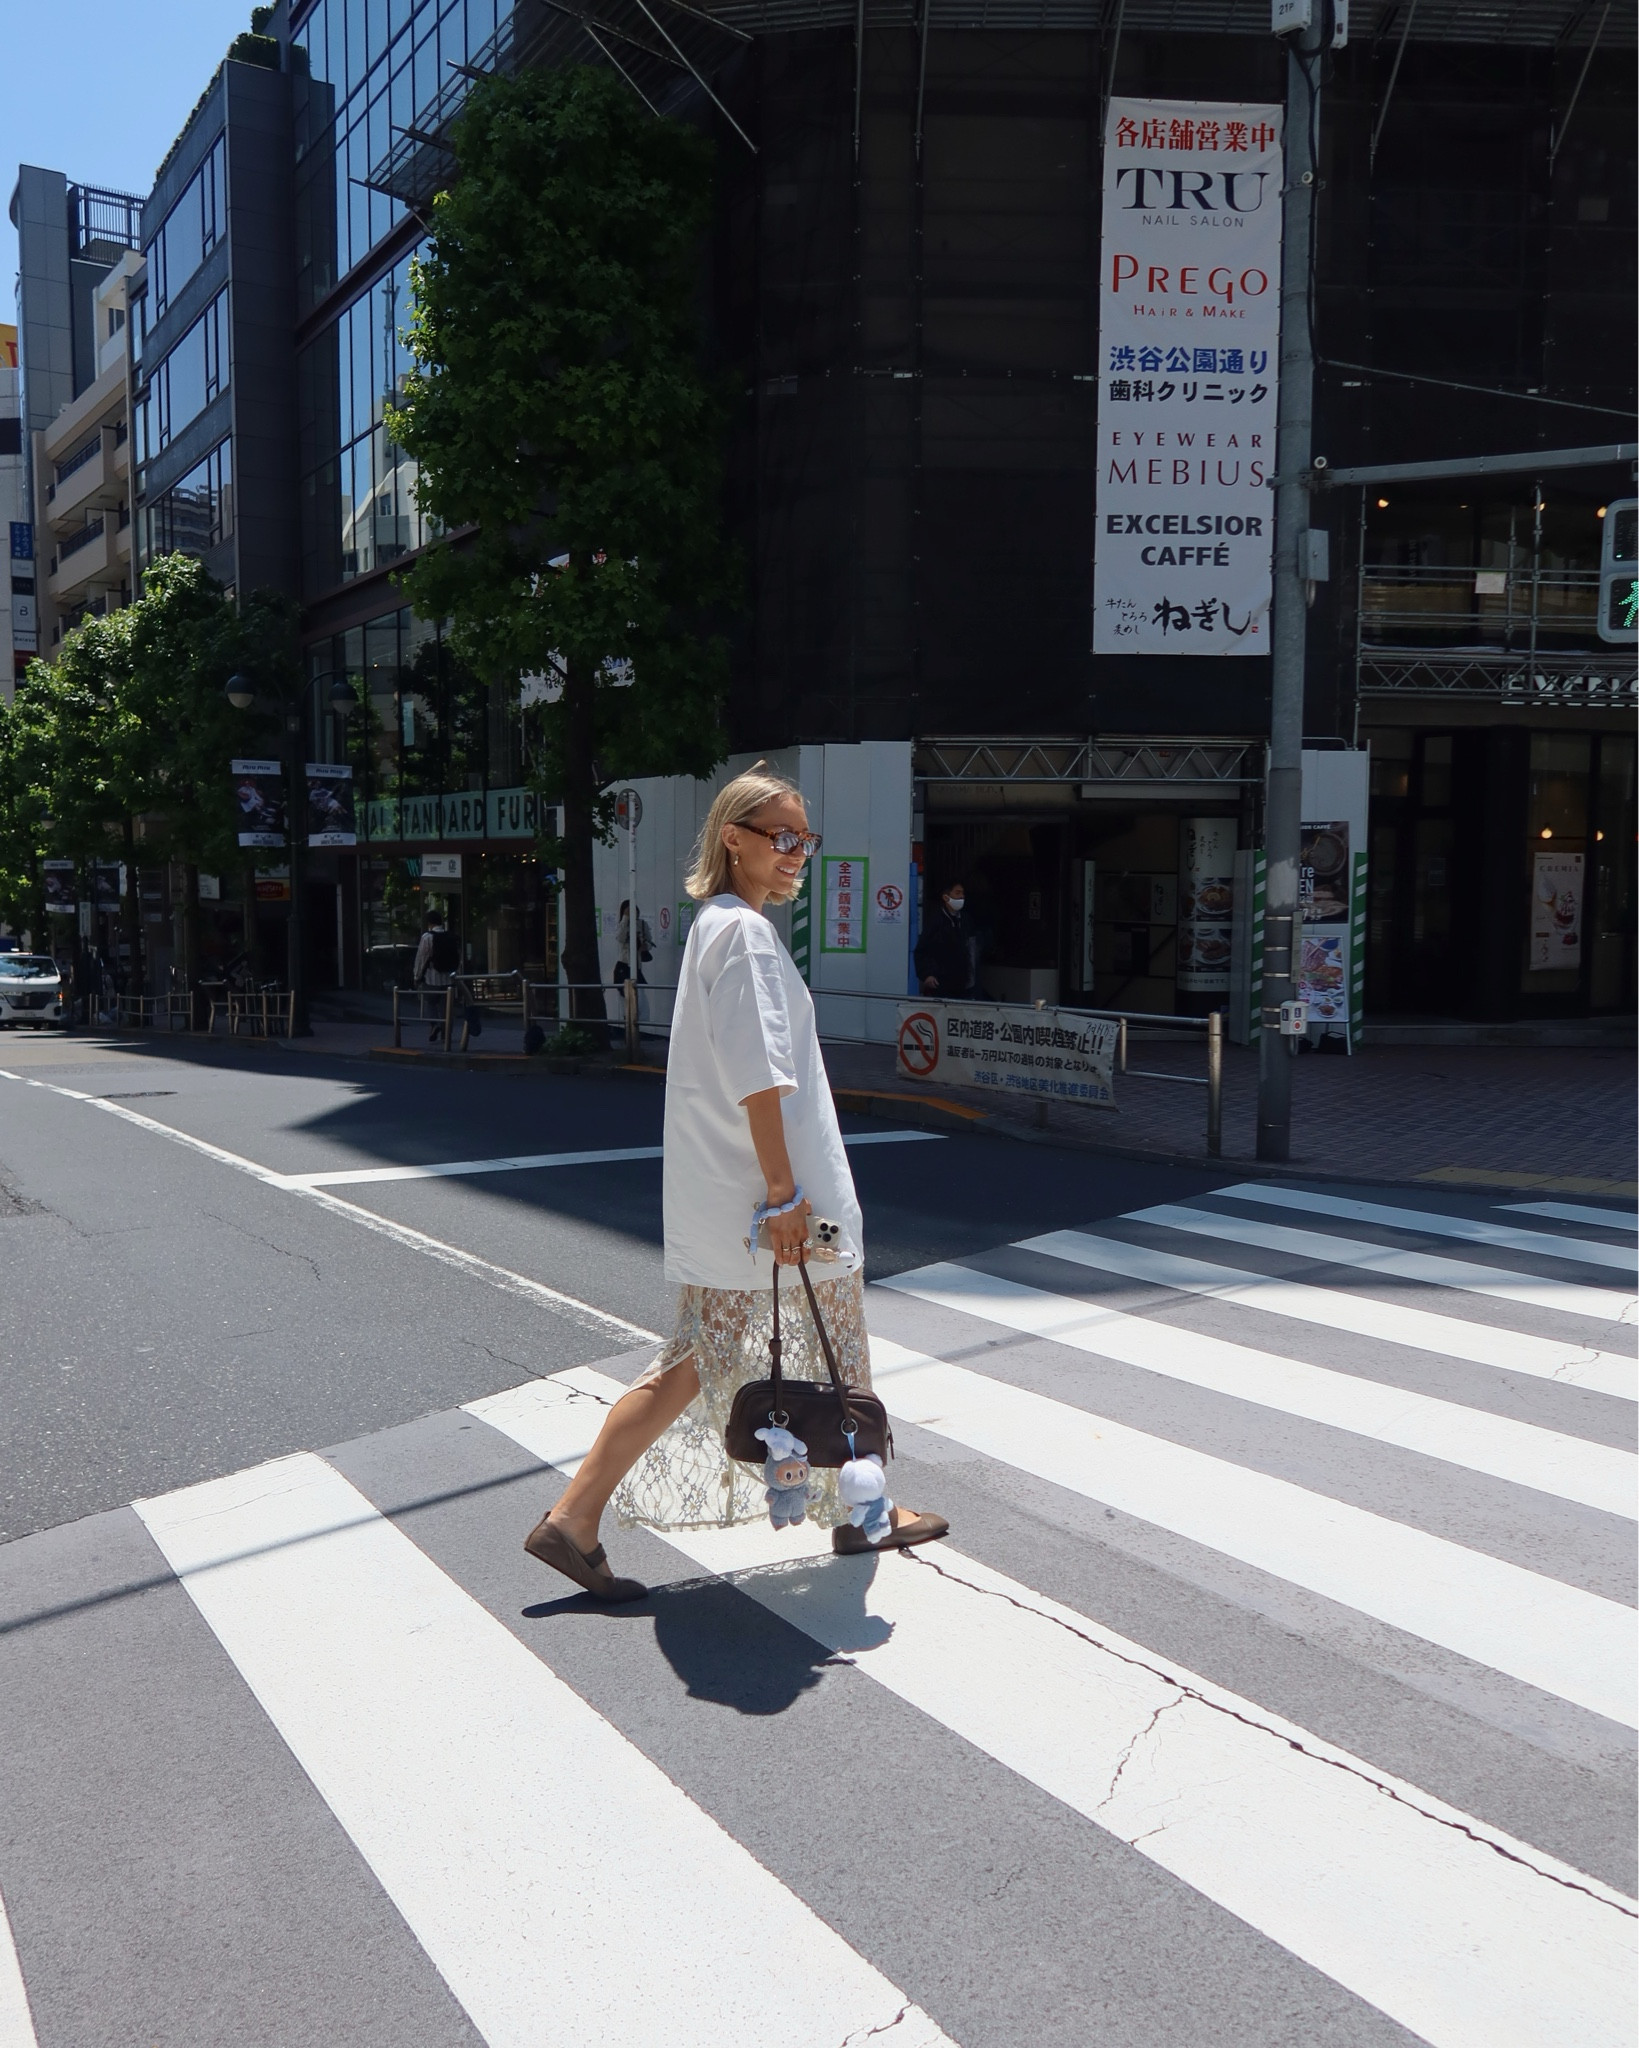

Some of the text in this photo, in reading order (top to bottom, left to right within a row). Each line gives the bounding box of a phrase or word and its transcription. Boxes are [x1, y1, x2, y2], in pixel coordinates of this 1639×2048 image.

[1115, 116, 1275, 153] 各店舗営業中
[1116, 167, 1270, 213] TRU
[1142, 215, 1244, 228] NAIL SALON
[1185, 308, 1193, 317] &
[1203, 305, 1246, 319] MAKE
[1109, 345, 1268, 375] 渋谷公園通り
[1109, 380, 1269, 404] 歯科クリニック
[1112, 431, 1262, 448] EYEWEAR
[1108, 458, 1265, 487] MEBIUS
[1106, 514, 1263, 537] EXCELSIOR
[1140, 541, 1230, 567] CAFFÉ
[1151, 595, 1252, 636] ねぎし
[359, 792, 538, 836] NAL STANDARD FUR
